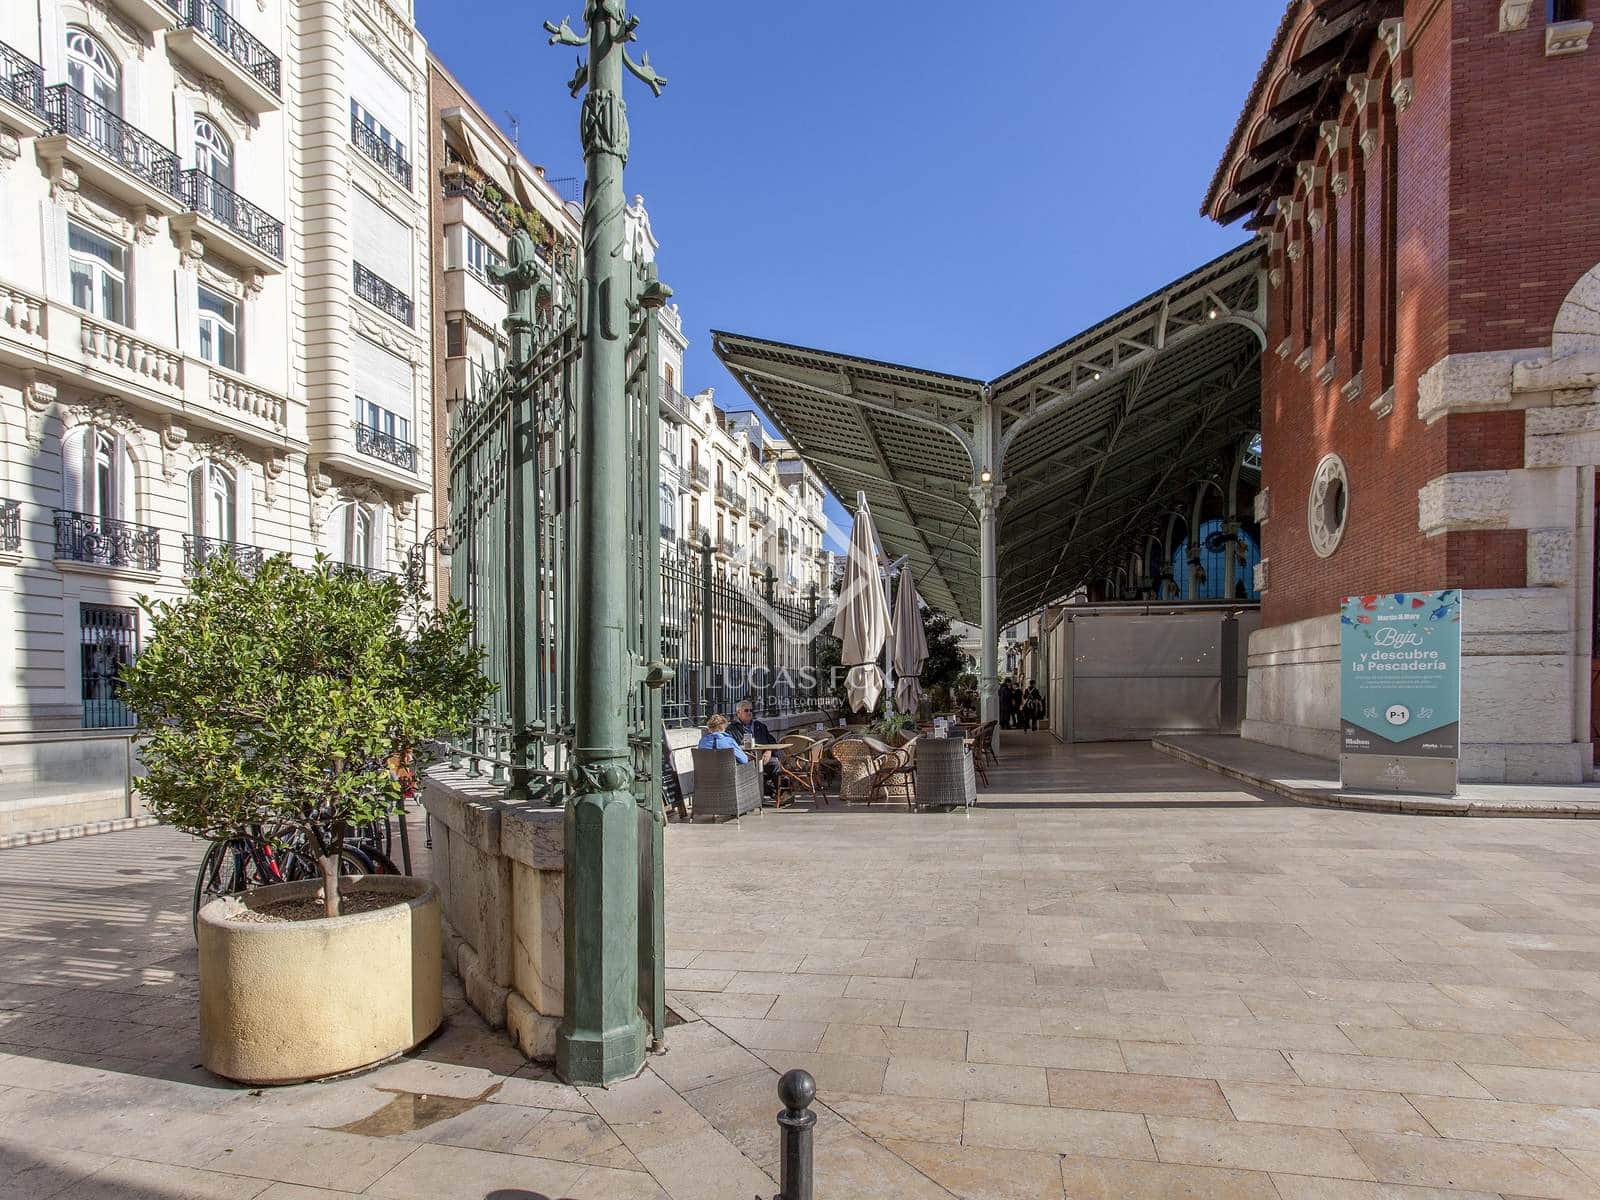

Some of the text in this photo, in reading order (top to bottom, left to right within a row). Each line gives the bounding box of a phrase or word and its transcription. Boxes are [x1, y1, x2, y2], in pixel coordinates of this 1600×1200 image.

[1374, 627, 1423, 649] Baja
[1360, 649, 1438, 662] y descubre
[1352, 659, 1446, 672] la Pescadería
[1390, 711, 1405, 719] P-1
